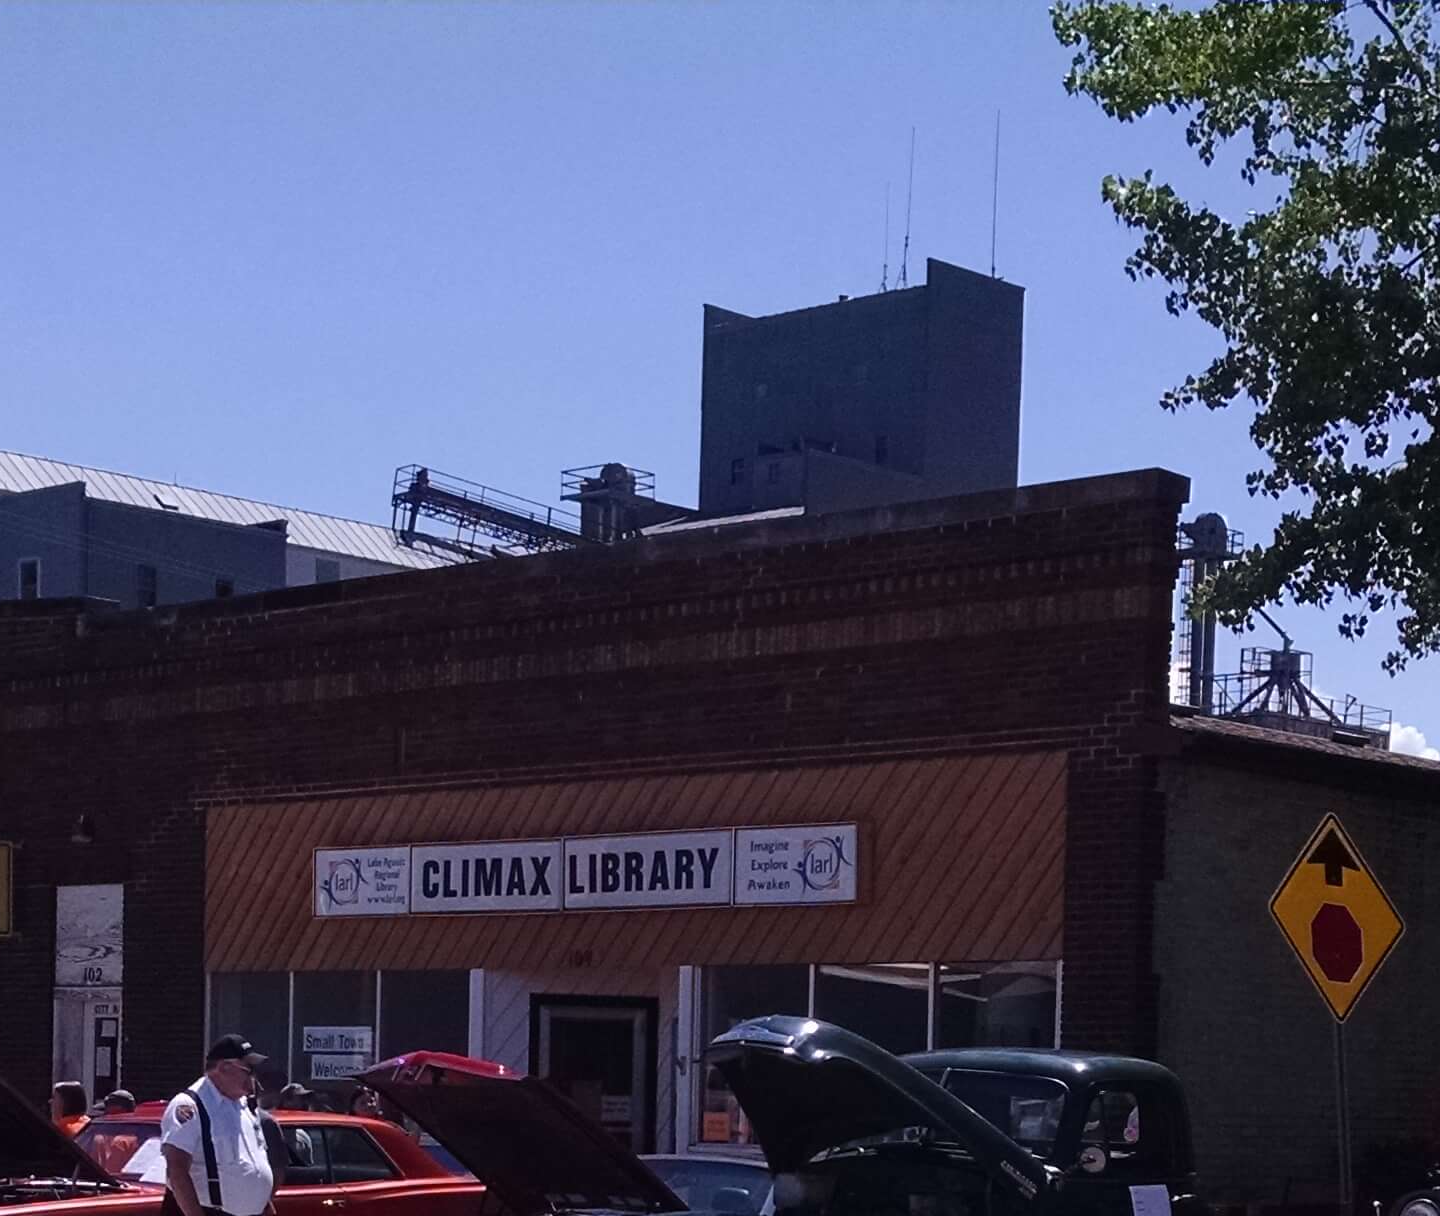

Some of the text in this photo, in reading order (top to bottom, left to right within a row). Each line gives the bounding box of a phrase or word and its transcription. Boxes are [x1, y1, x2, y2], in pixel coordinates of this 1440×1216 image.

[751, 841, 789, 854] Imagine
[751, 858, 788, 872] Explore
[422, 847, 720, 899] CLIMAX LIBRARY
[747, 878, 790, 890] Awaken
[84, 967, 103, 982] 102
[306, 1034, 335, 1049] Small
